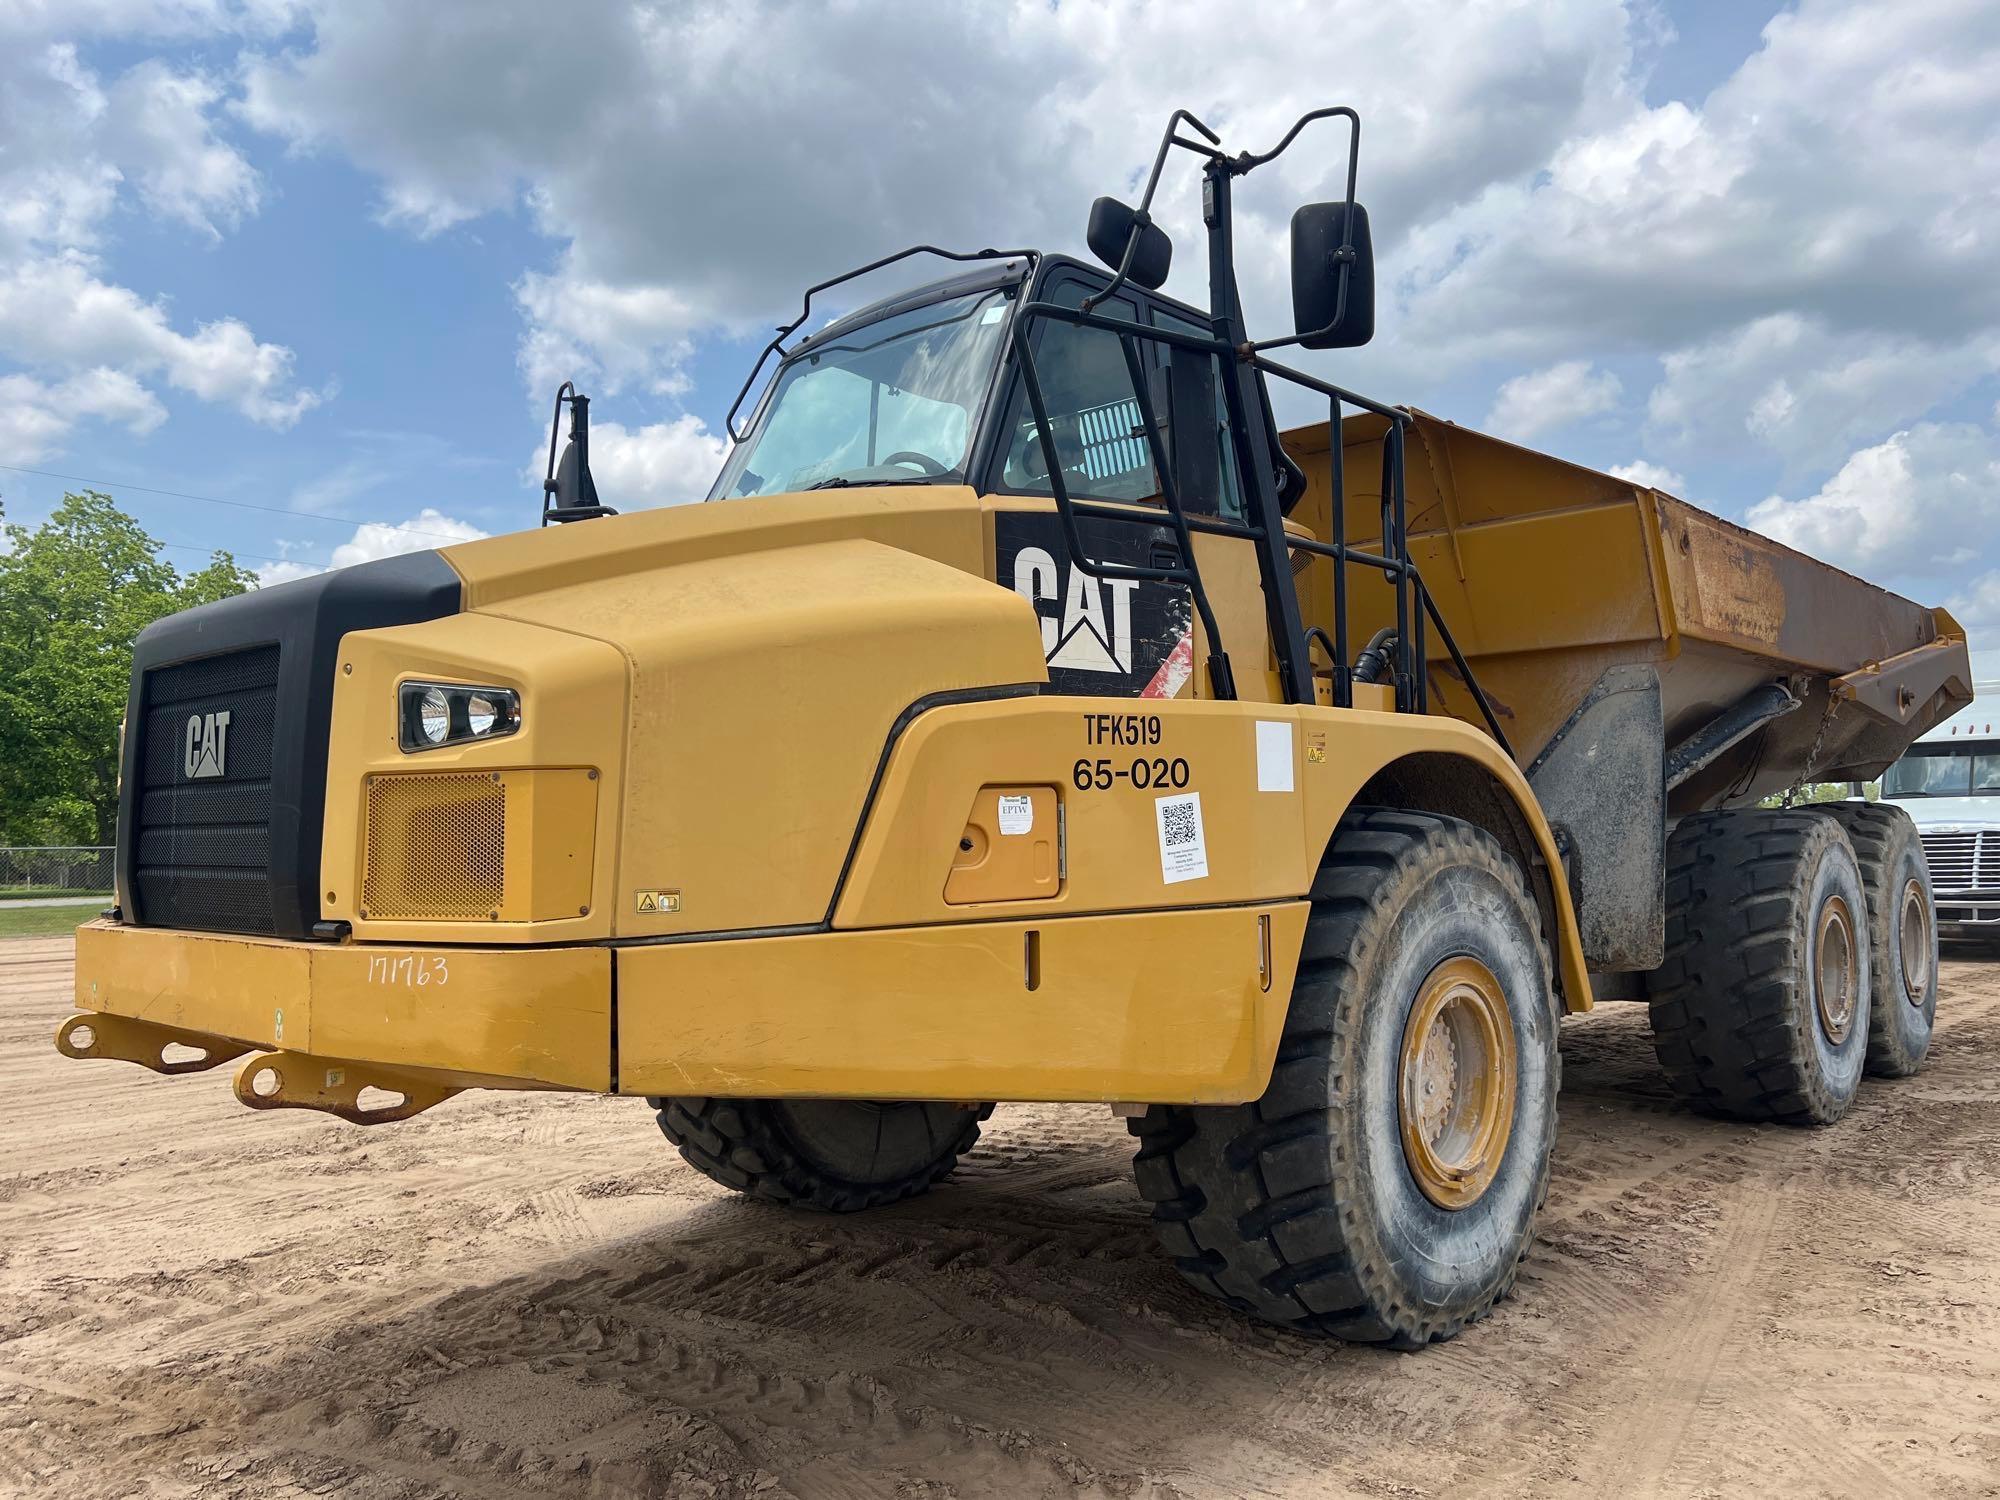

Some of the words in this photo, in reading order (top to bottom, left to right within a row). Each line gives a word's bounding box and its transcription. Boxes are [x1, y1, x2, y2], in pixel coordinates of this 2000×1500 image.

[1014, 547, 1140, 674] CAT
[185, 711, 230, 778] CAT
[1083, 714, 1161, 745] TFK519
[1073, 758, 1190, 790] 65-020
[1002, 805, 1027, 814] EPTW
[368, 955, 448, 987] 171763
